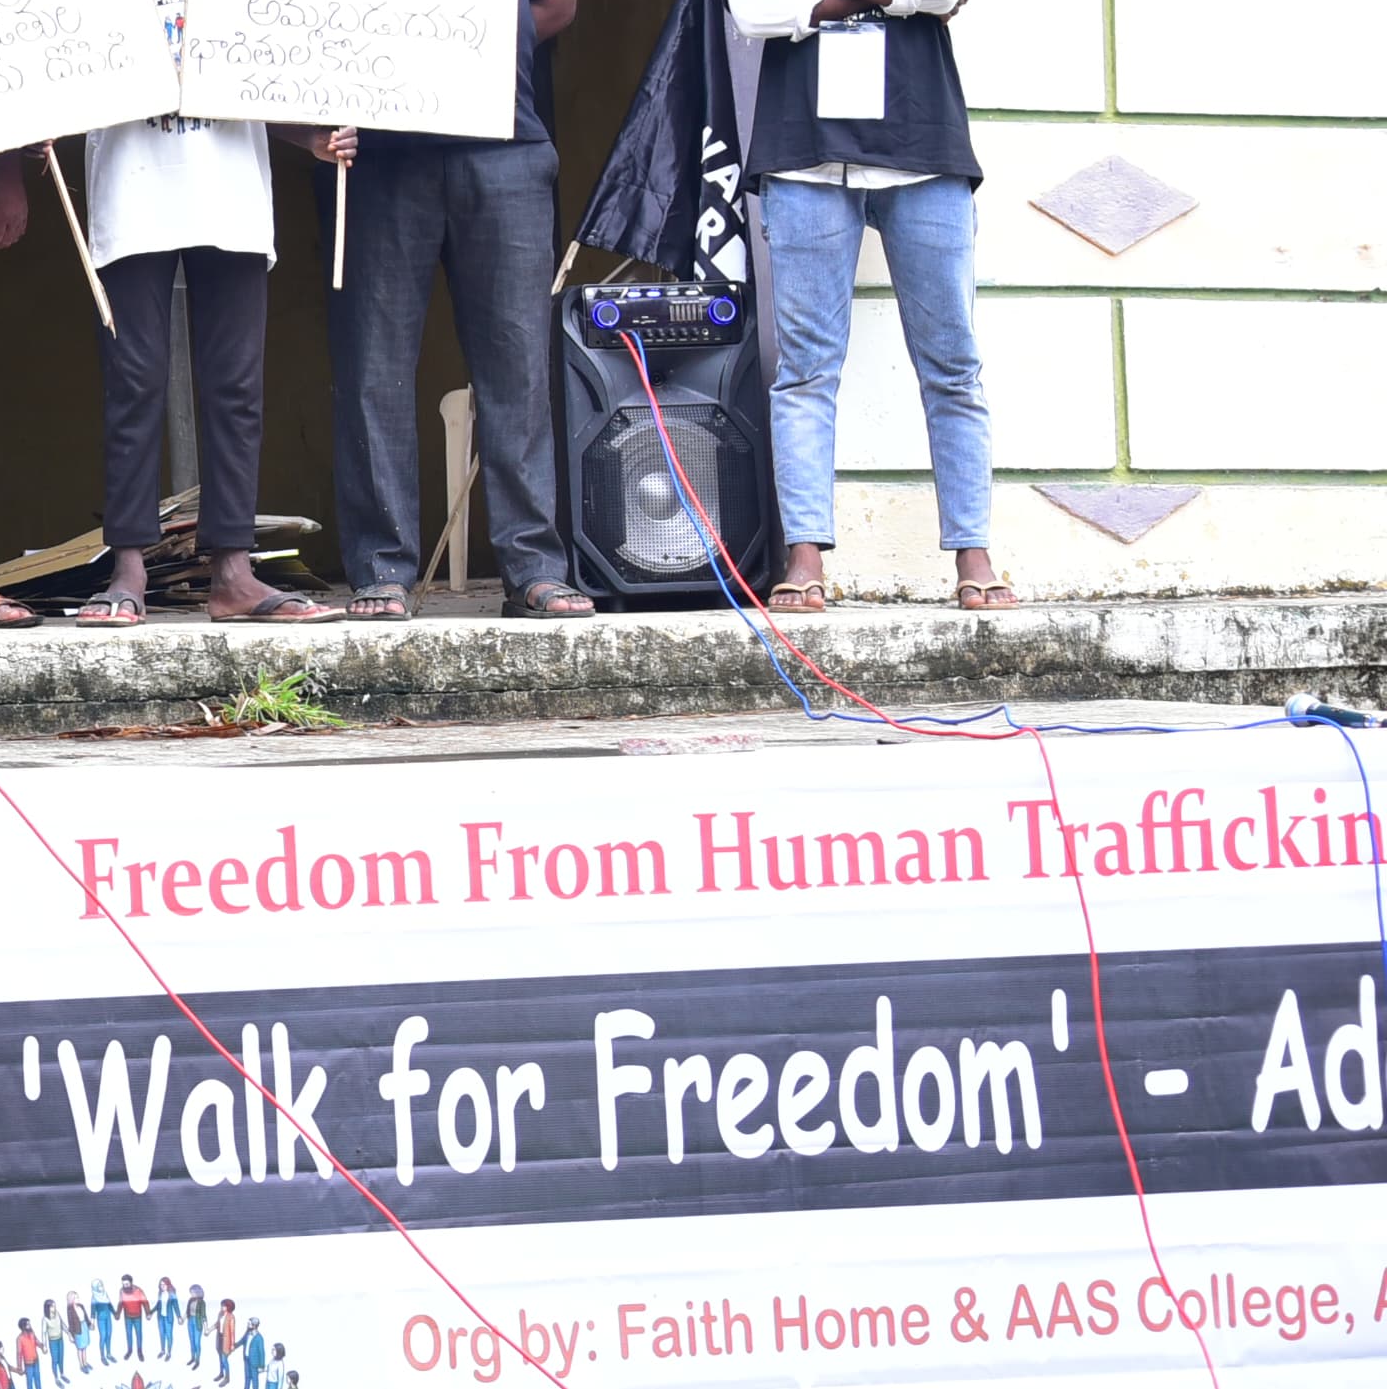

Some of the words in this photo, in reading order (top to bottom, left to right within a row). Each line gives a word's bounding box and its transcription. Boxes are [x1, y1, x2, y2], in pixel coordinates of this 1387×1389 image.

[320, 39, 395, 79] కోసం
[74, 824, 439, 919] Freedom
[460, 822, 672, 903] From
[692, 812, 989, 893] Human
[22, 1022, 334, 1194] 'Walk
[379, 1015, 546, 1186] for
[594, 989, 1070, 1169] Freedom'
[1252, 974, 1387, 1134] Ad
[403, 1312, 502, 1384] Org
[518, 1309, 596, 1377] by:
[618, 1299, 754, 1360] Faith
[774, 1295, 930, 1352] Home
[951, 1287, 989, 1343] &
[1007, 1279, 1120, 1340] AAS
[1138, 1271, 1355, 1342] College,
